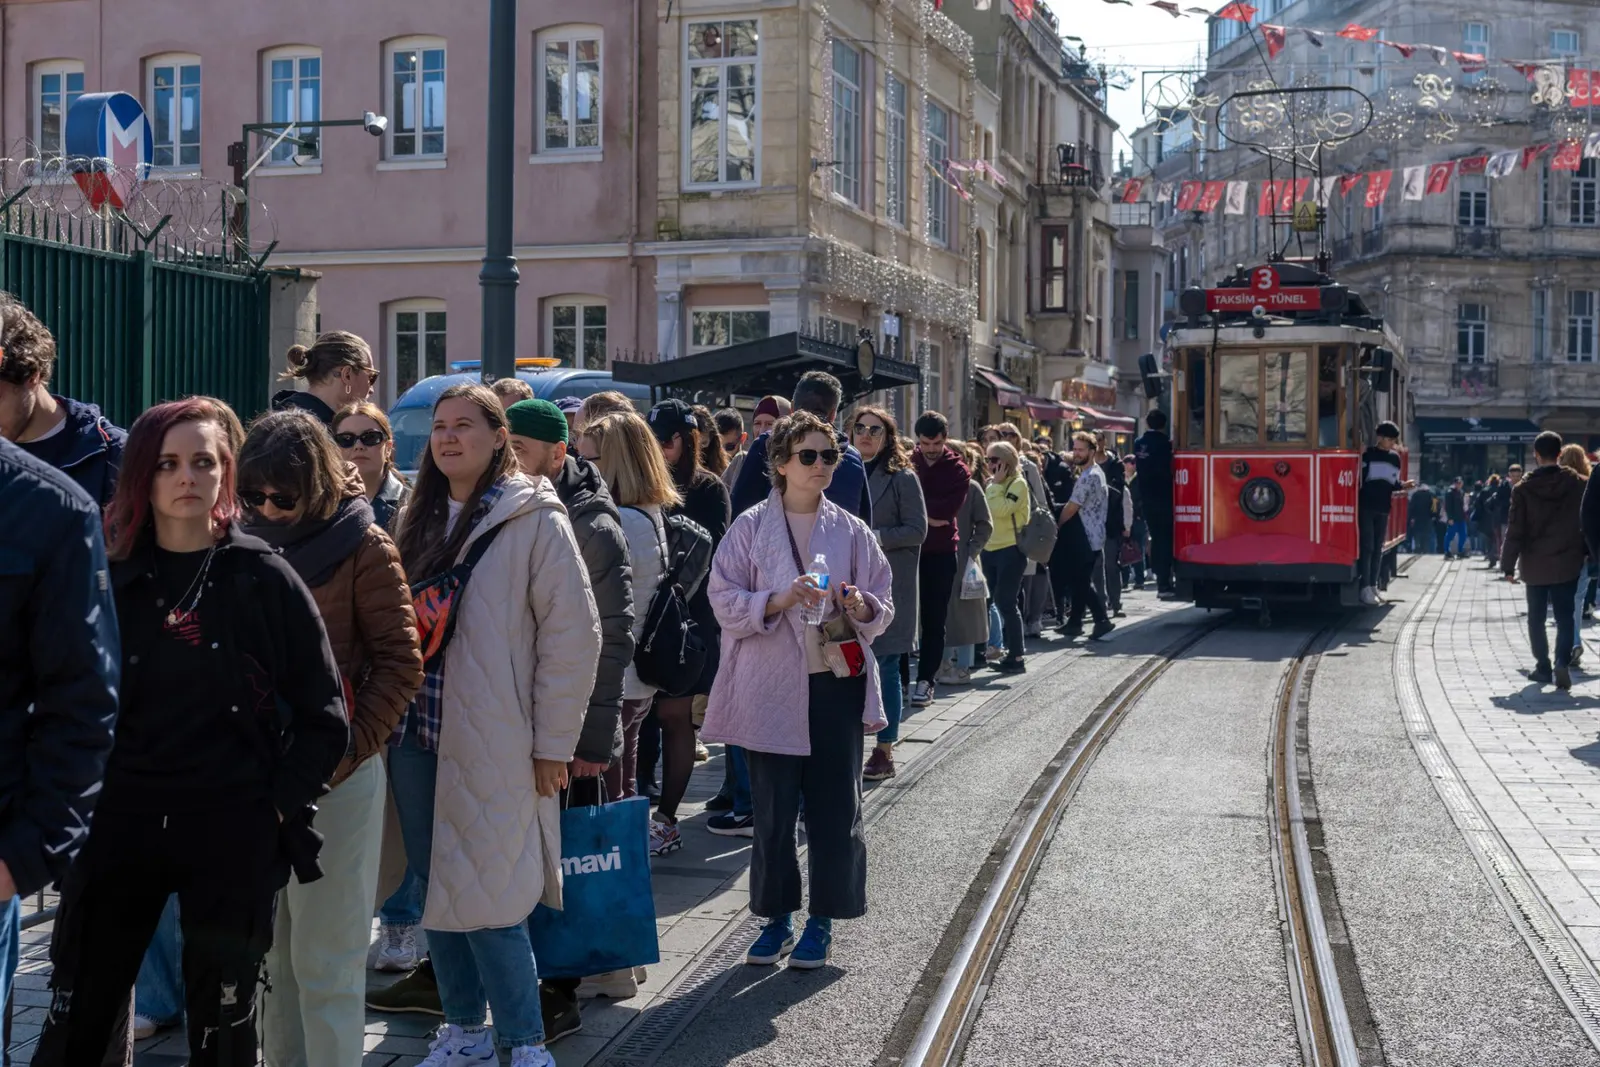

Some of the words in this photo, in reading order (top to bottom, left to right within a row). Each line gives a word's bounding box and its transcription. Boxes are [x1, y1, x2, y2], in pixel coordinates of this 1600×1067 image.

[105, 101, 145, 181] M
[1257, 268, 1273, 290] 3
[1213, 293, 1255, 305] TAKSİM
[1270, 293, 1307, 304] TÜNEL
[1337, 469, 1354, 487] 410
[561, 846, 622, 876] mavi
